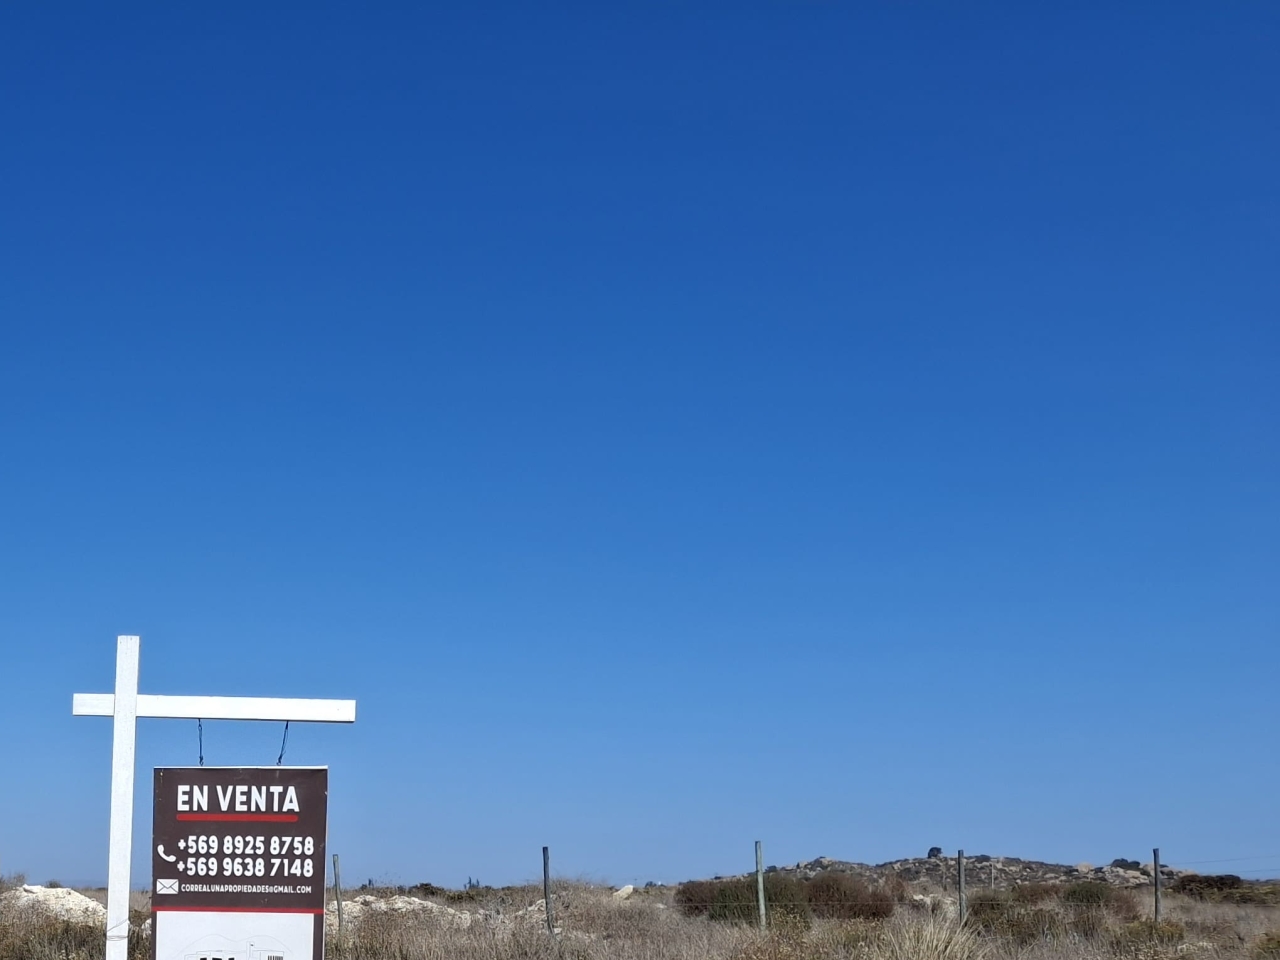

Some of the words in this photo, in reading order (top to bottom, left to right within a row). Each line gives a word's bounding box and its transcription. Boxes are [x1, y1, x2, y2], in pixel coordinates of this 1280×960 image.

[177, 785, 208, 811] EN
[216, 785, 300, 812] VENTA
[177, 835, 219, 855] +569
[223, 835, 265, 855] 8925
[270, 836, 314, 856] 8758
[177, 857, 218, 876] +569
[222, 857, 265, 877] 9638
[269, 858, 314, 878] 7148
